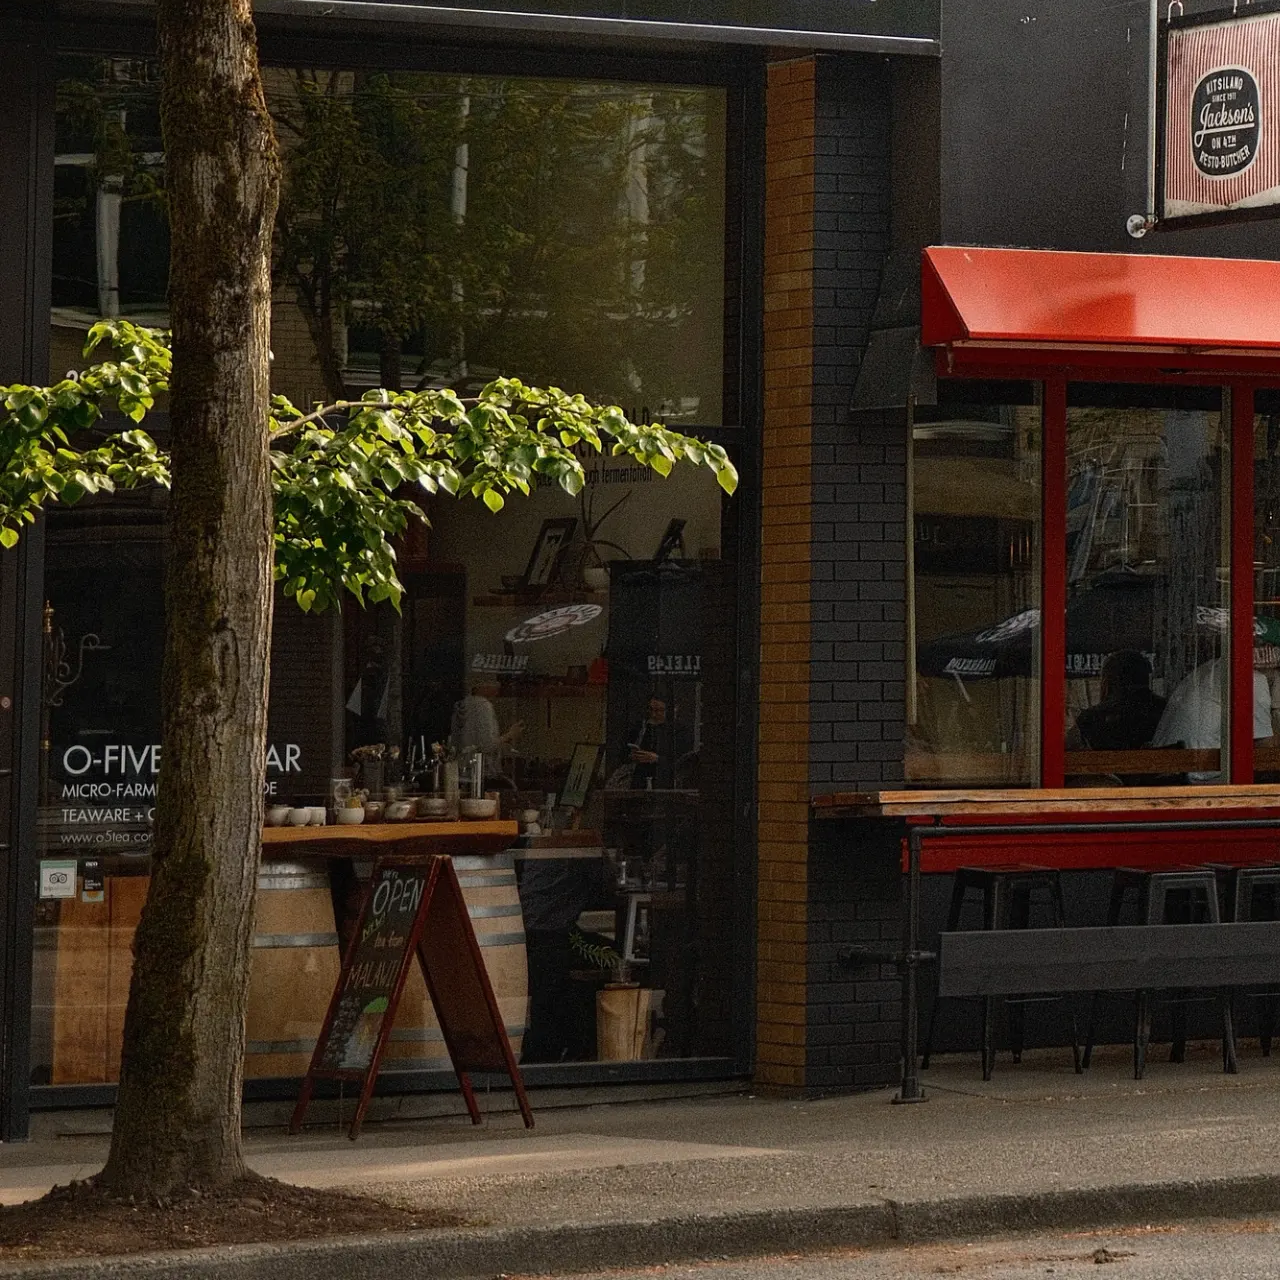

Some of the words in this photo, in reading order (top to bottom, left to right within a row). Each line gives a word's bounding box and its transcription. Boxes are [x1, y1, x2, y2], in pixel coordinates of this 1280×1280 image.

[1206, 76, 1243, 95] KITSILANO
[1211, 94, 1226, 102] SINCE
[1194, 102, 1254, 147] Jackson's
[1211, 137, 1221, 149] ON
[1222, 135, 1237, 148] 4TH
[62, 744, 162, 775] O-FIVE
[61, 807, 131, 823] TEAWARE
[372, 878, 426, 916] OPEN
